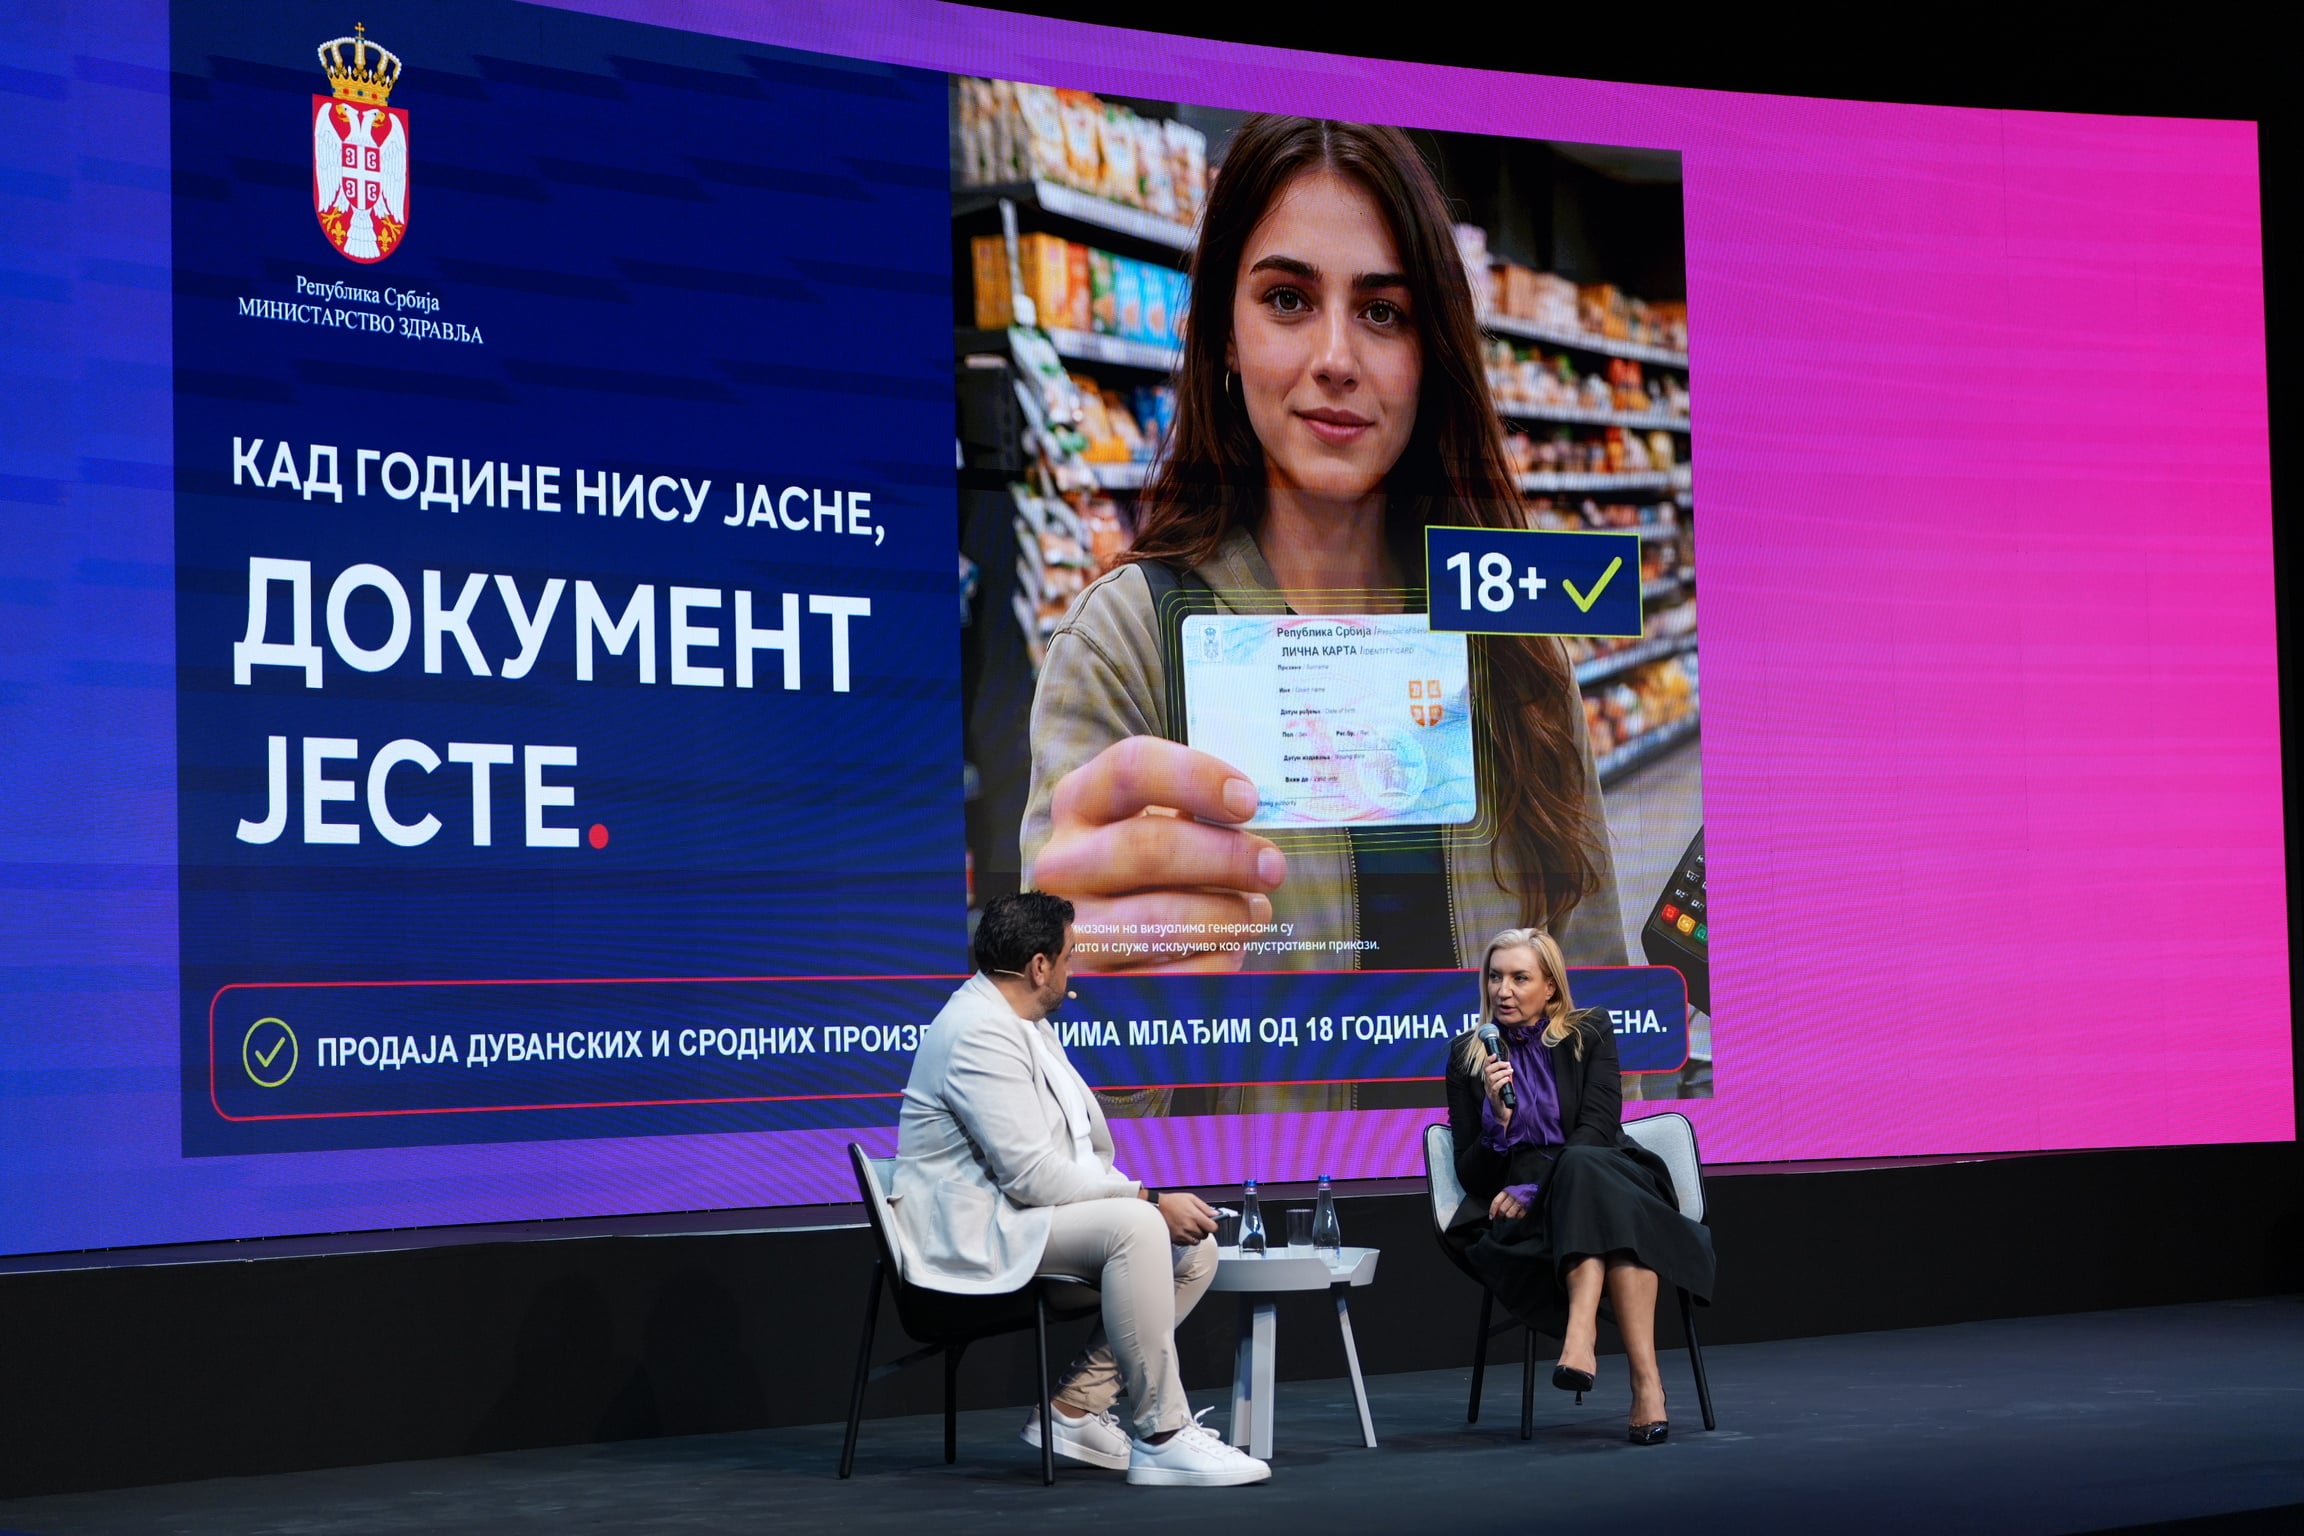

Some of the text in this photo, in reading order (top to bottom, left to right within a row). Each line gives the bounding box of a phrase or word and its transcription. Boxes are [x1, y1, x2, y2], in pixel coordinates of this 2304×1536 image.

[296, 275, 441, 315] Република Србија
[238, 296, 486, 344] МИНИСТАРСТВО ЗДРАВЉА
[233, 436, 886, 547] КАД ГОДИНЕ НИСУ ЈАСНЕ,
[1446, 551, 1548, 613] 18+
[233, 556, 873, 693] ДОКУМЕНТ
[1276, 627, 1333, 640] Република
[1336, 626, 1372, 639] Србија
[1282, 646, 1319, 657] ЛИЧНА
[1322, 645, 1358, 656] КАРТА
[235, 735, 610, 850] ЈЕСТЕ.
[1101, 942, 1109, 953] и
[1111, 942, 1149, 957] служе
[1151, 940, 1217, 955] искључиво
[1219, 941, 1241, 952] као
[1243, 940, 1327, 955] илустративни
[1328, 939, 1381, 954] прикази.
[1122, 923, 1138, 934] на
[1140, 923, 1206, 938] визуалима
[1207, 922, 1278, 937] генерисани
[1280, 922, 1294, 937] су
[317, 1034, 459, 1071] ПРОДАЈА
[466, 1029, 644, 1069] ДУВАНСКИХ
[651, 1029, 670, 1058] И
[678, 1026, 816, 1061] СРОДНИХ
[1128, 1017, 1251, 1047] МЛАЂИМ
[1258, 1017, 1299, 1048] ОД
[1305, 1016, 1334, 1042] 18
[1341, 1014, 1449, 1045] ГОДИНА
